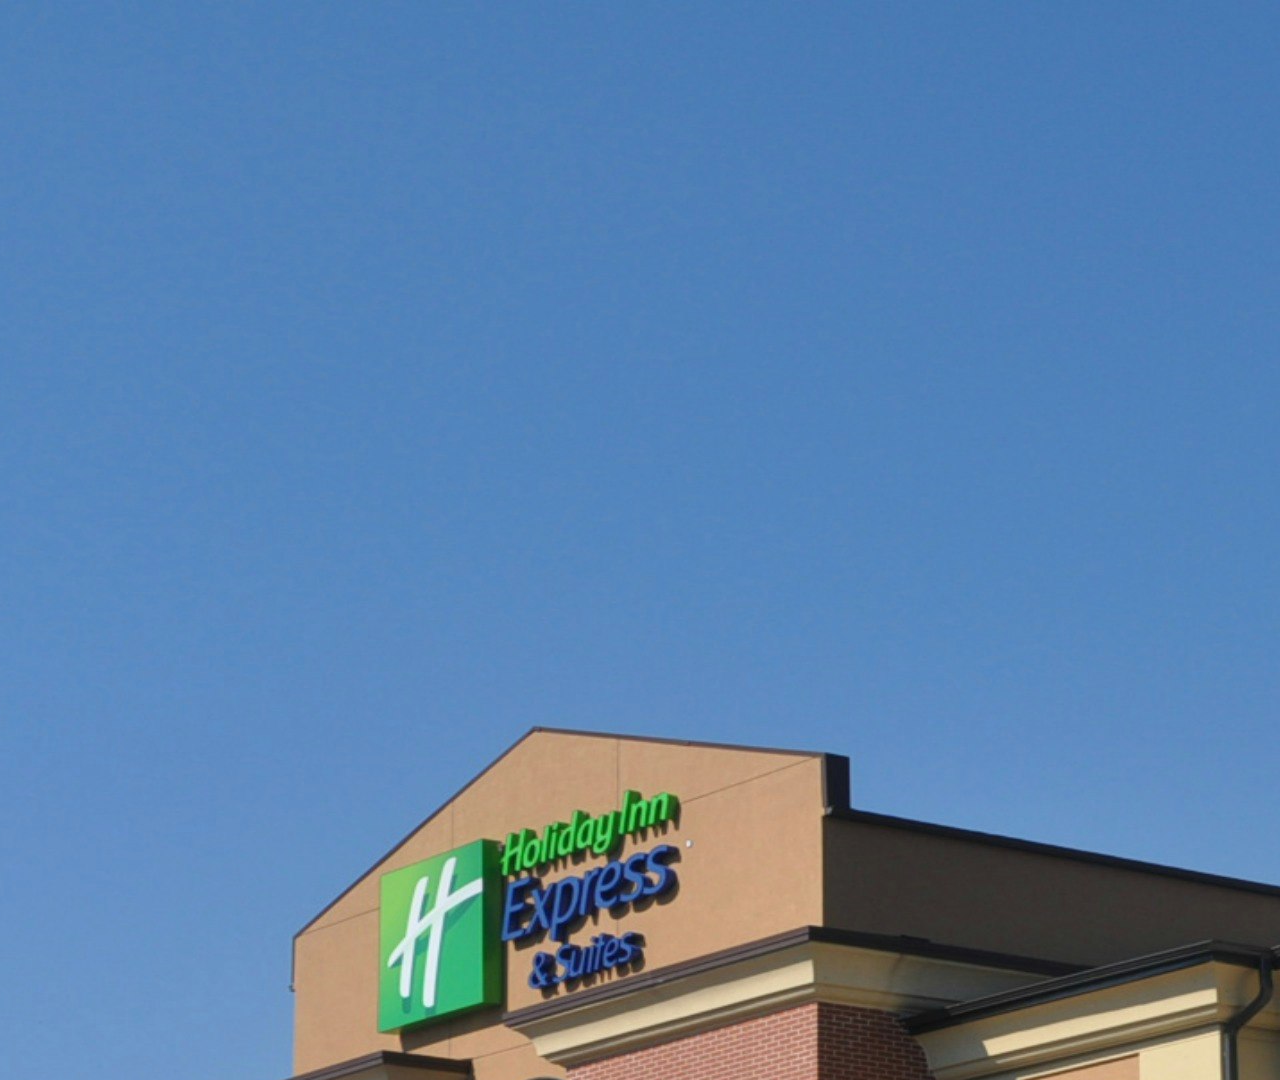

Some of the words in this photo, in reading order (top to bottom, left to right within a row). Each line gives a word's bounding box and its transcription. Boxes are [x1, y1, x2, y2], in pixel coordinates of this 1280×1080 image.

[501, 809, 618, 876] Holiday
[618, 790, 675, 834] Inn
[501, 844, 674, 941] Express
[529, 951, 553, 989] &
[553, 931, 639, 984] Suites
